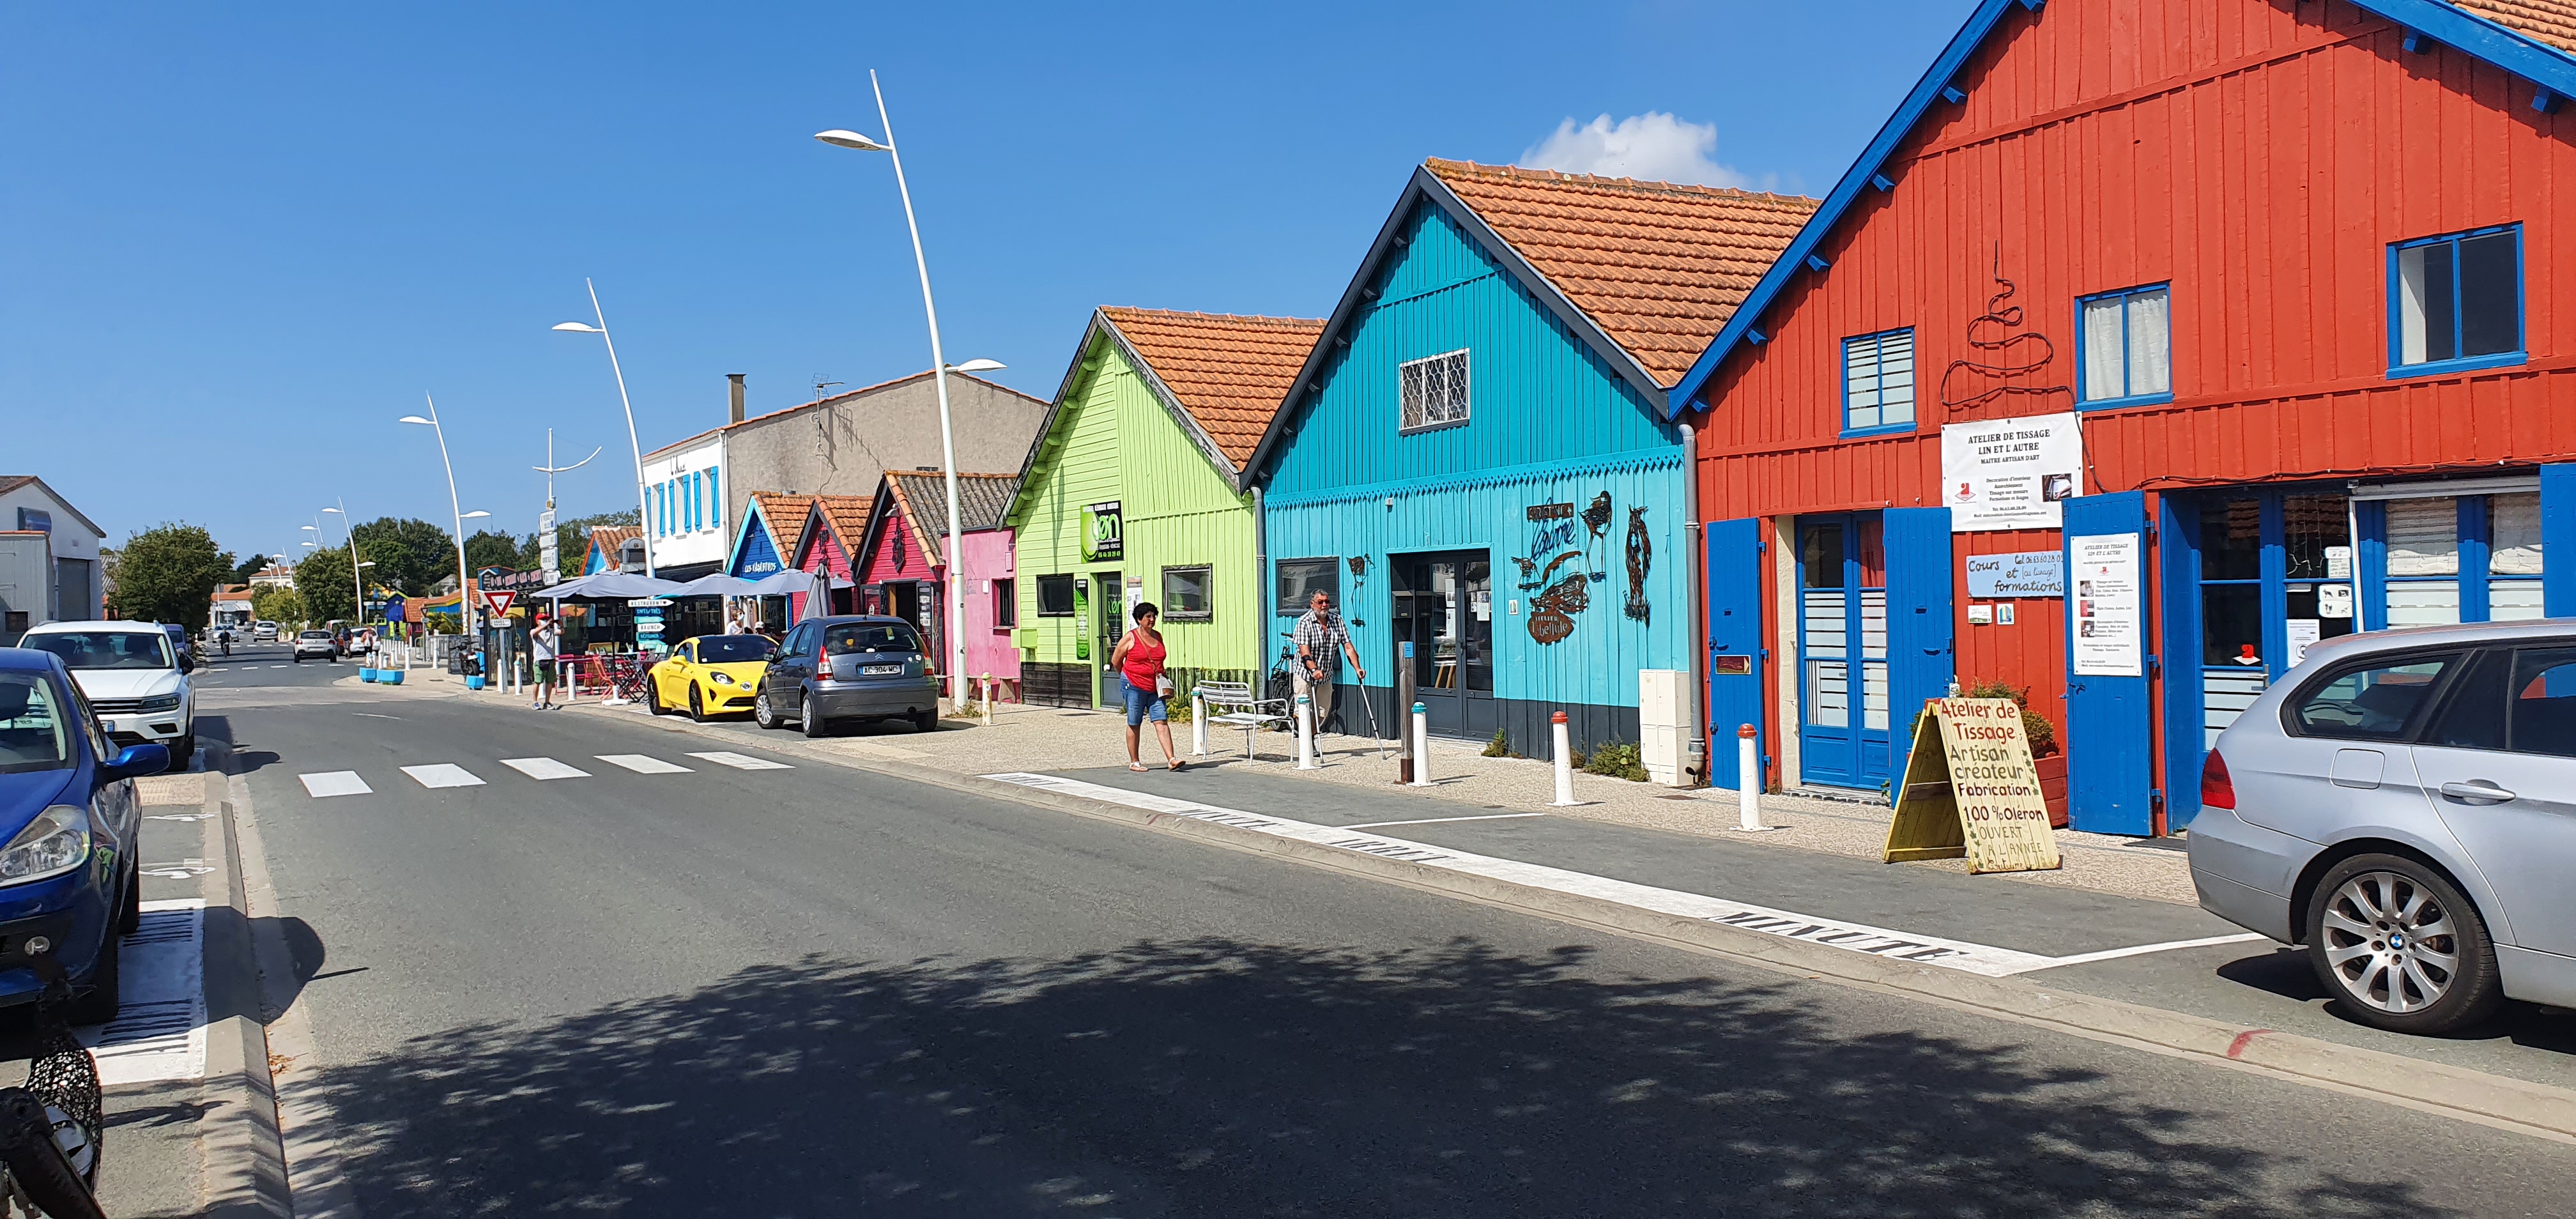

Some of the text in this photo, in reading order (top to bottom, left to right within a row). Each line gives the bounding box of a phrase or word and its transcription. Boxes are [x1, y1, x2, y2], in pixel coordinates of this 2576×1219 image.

[1968, 429, 2050, 444] ATELIER DE TISSAGE
[1994, 445, 2004, 454] ET
[2012, 442, 2039, 452] AUTRE
[1968, 560, 2000, 572] Cours
[2015, 555, 2025, 564] tel
[2048, 555, 2055, 563] 28
[2005, 567, 2018, 578] et
[1995, 579, 2062, 594] formations
[1941, 700, 2016, 719] Atelier de
[1954, 723, 2016, 744] Tissage
[1950, 744, 2009, 762] Artisan
[1954, 762, 2024, 779] créateur
[1958, 782, 2030, 797] Fabrication
[1963, 806, 1989, 822] 100
[1979, 826, 2023, 840] OUVERT
[1699, 911, 1970, 961] MINUTE
